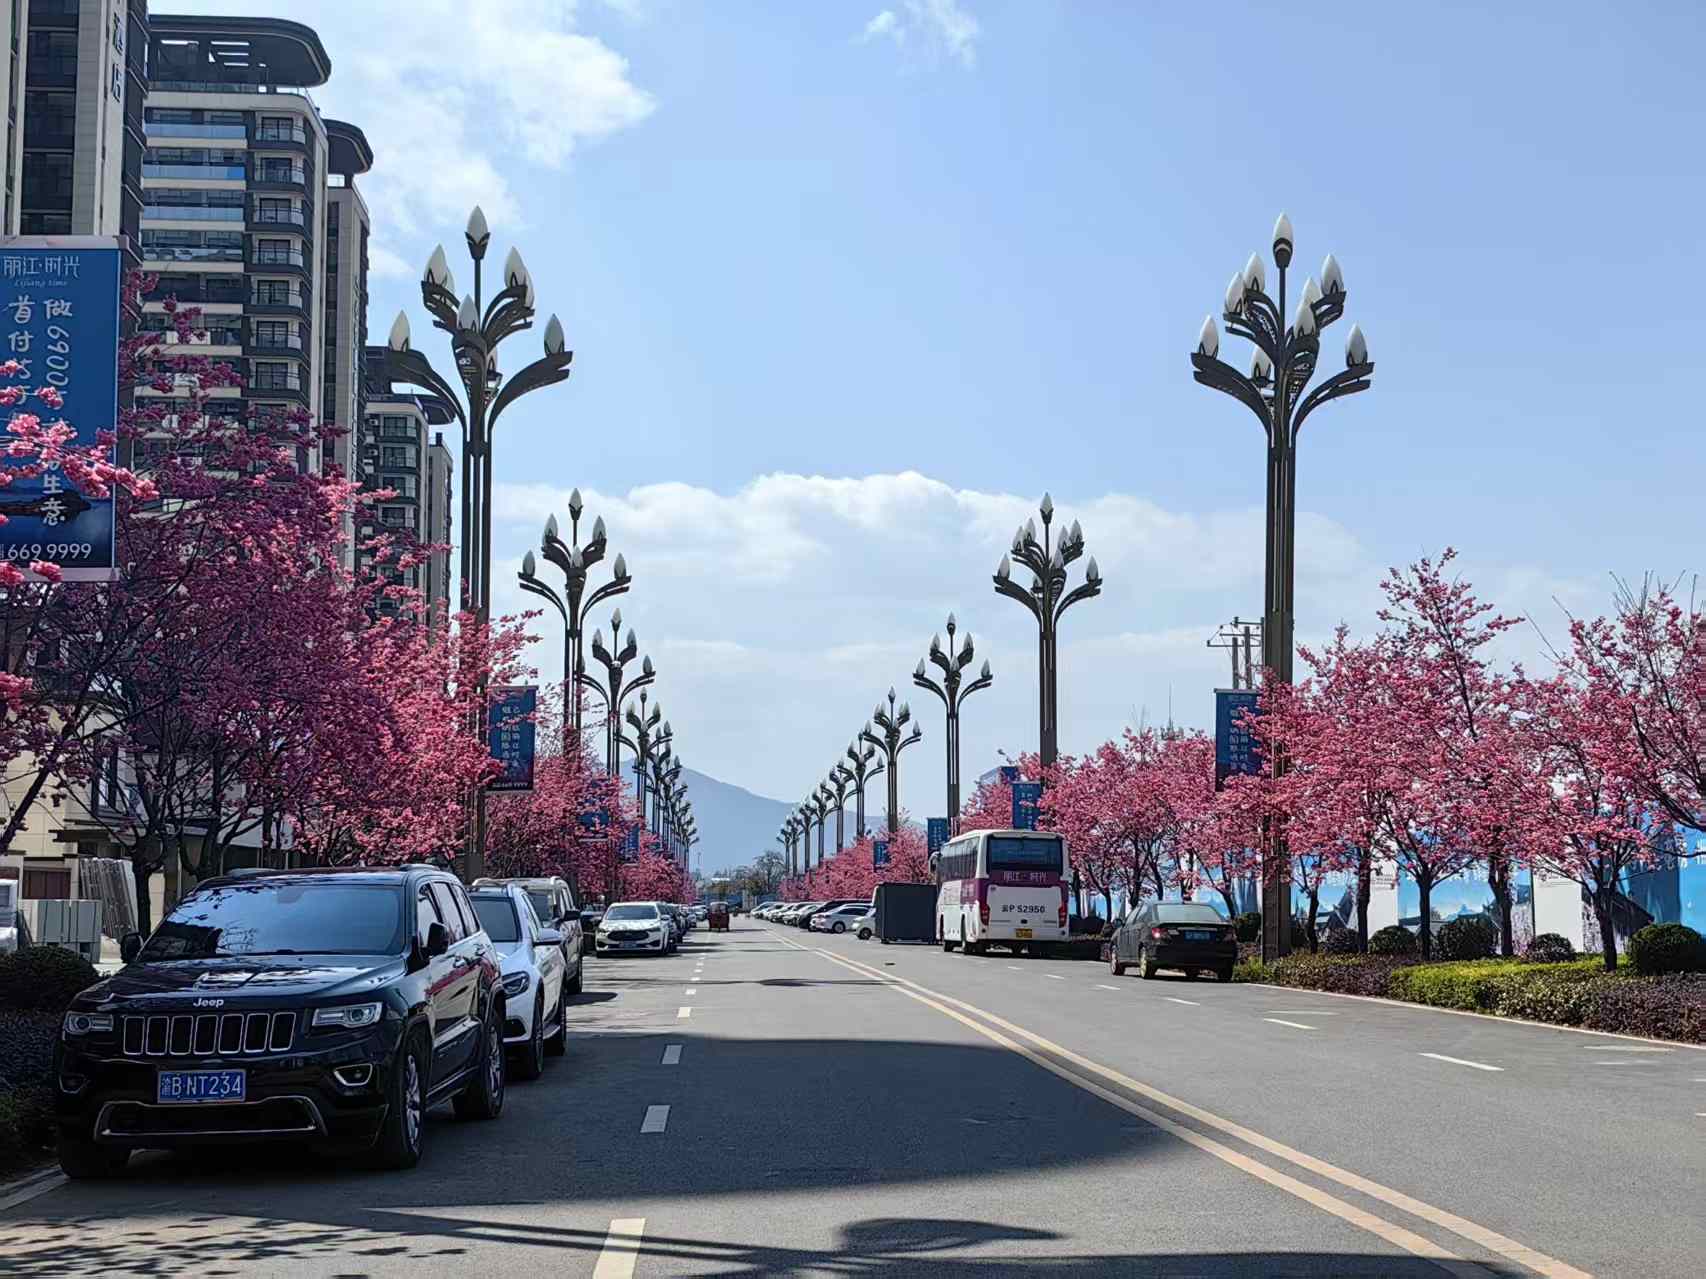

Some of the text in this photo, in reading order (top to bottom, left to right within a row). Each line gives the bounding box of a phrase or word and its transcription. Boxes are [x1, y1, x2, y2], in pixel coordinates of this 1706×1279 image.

[8, 543, 42, 560] 669
[46, 543, 92, 559] 9999
[193, 998, 224, 1008] Jeep
